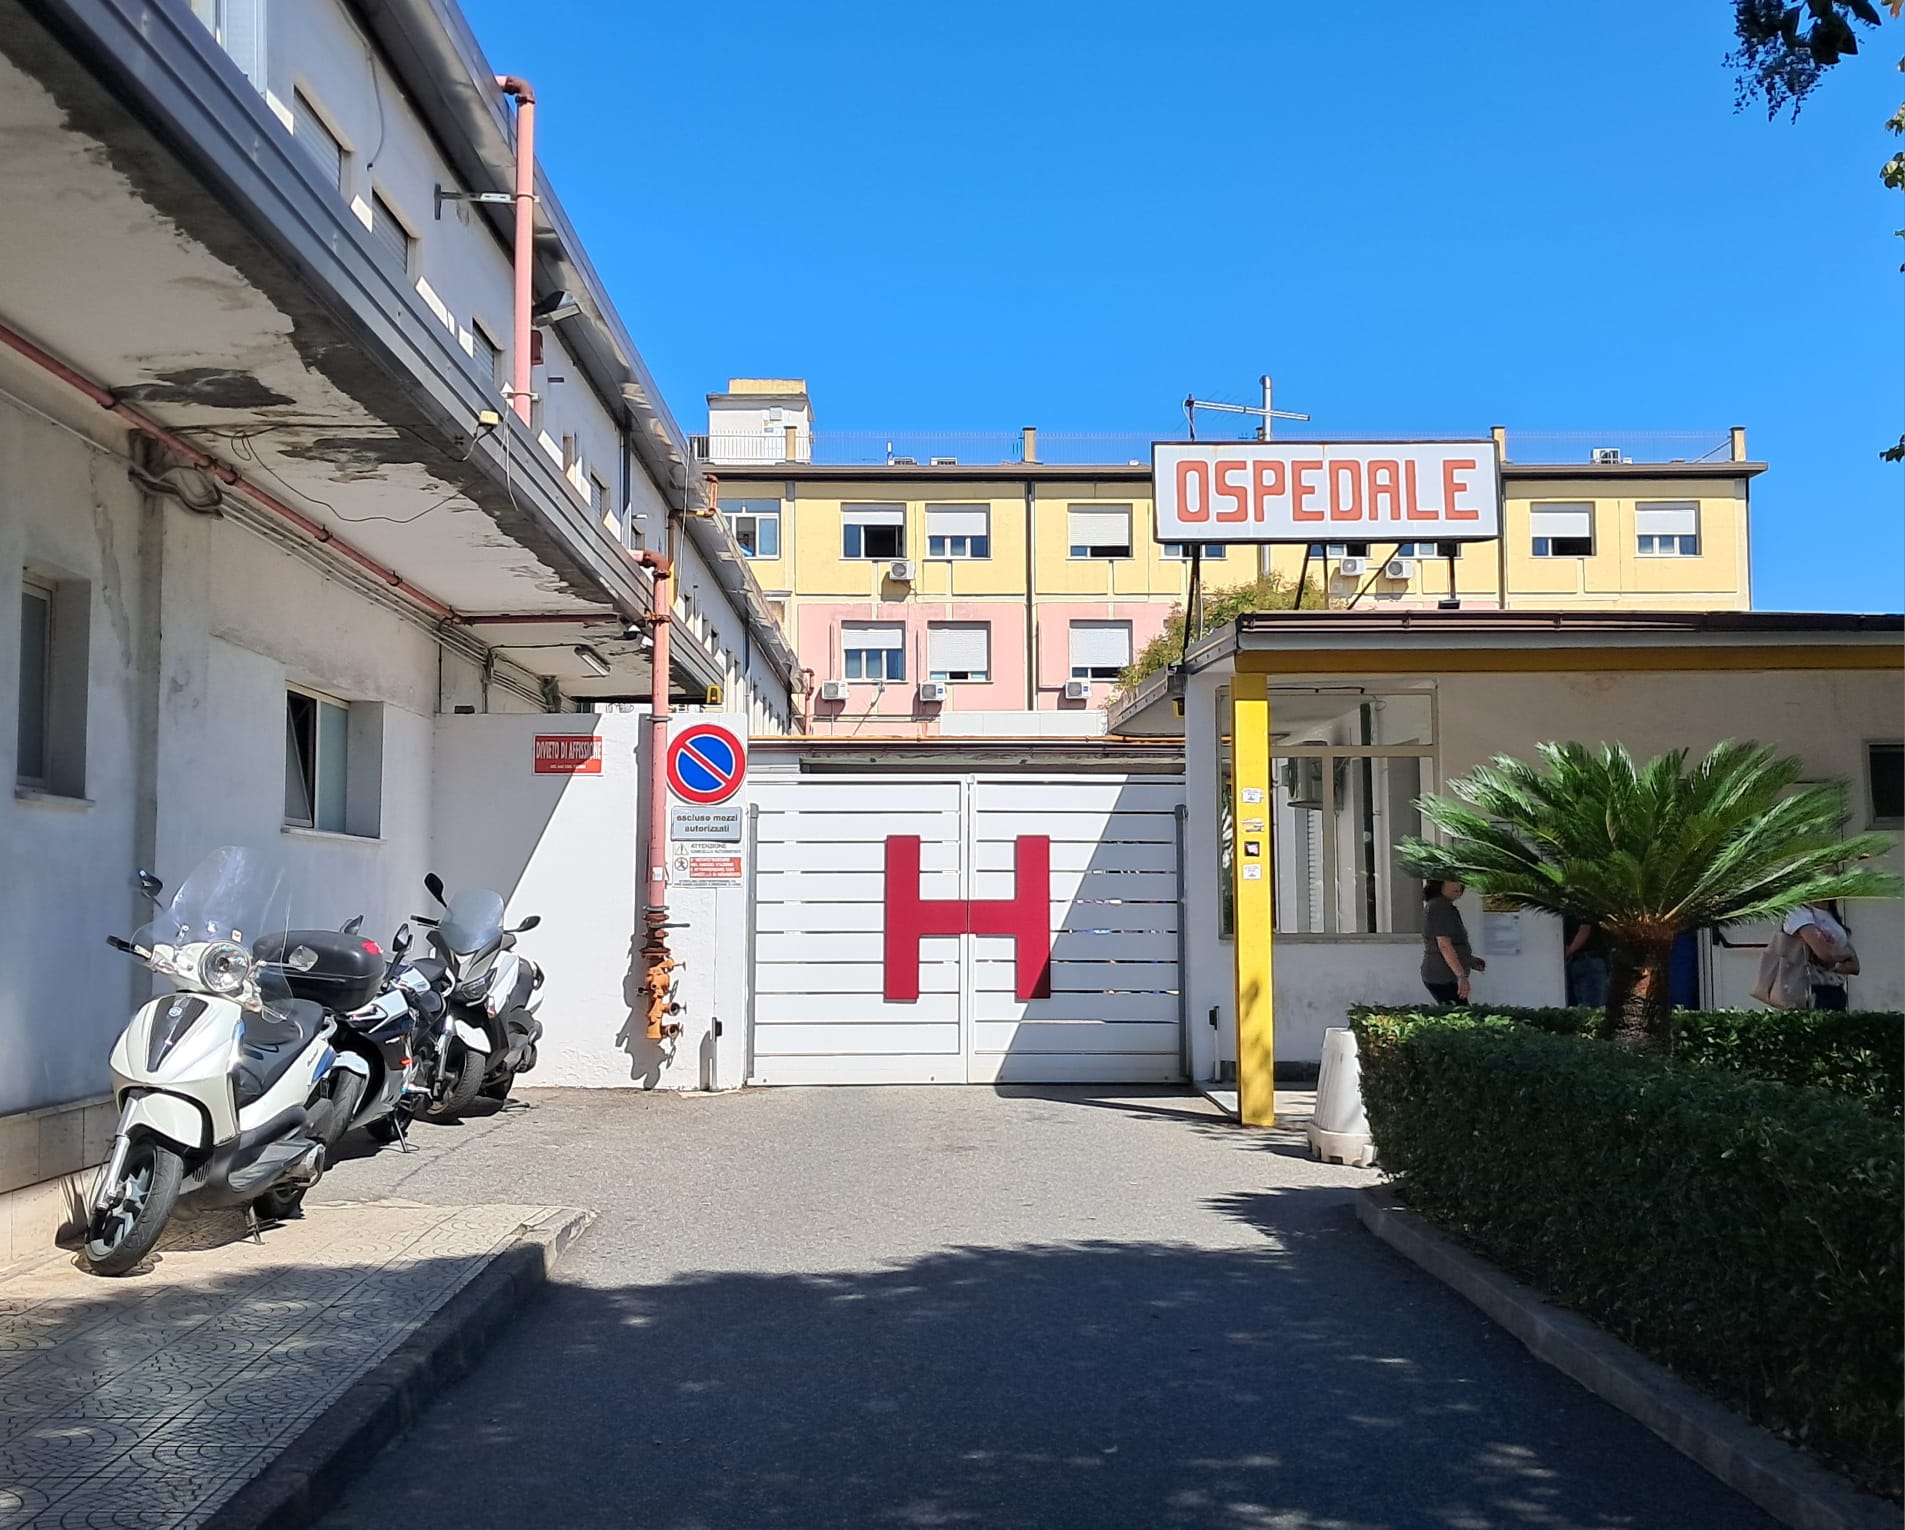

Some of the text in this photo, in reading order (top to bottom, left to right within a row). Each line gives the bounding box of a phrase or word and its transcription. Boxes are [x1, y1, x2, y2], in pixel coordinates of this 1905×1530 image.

[1177, 459, 1479, 522] OSPEDALE
[536, 741, 602, 759] DIVIETO DI AFFISSIONE
[676, 814, 738, 822] escluso mezzi
[684, 824, 730, 833] autorizzati
[884, 835, 1050, 999] H
